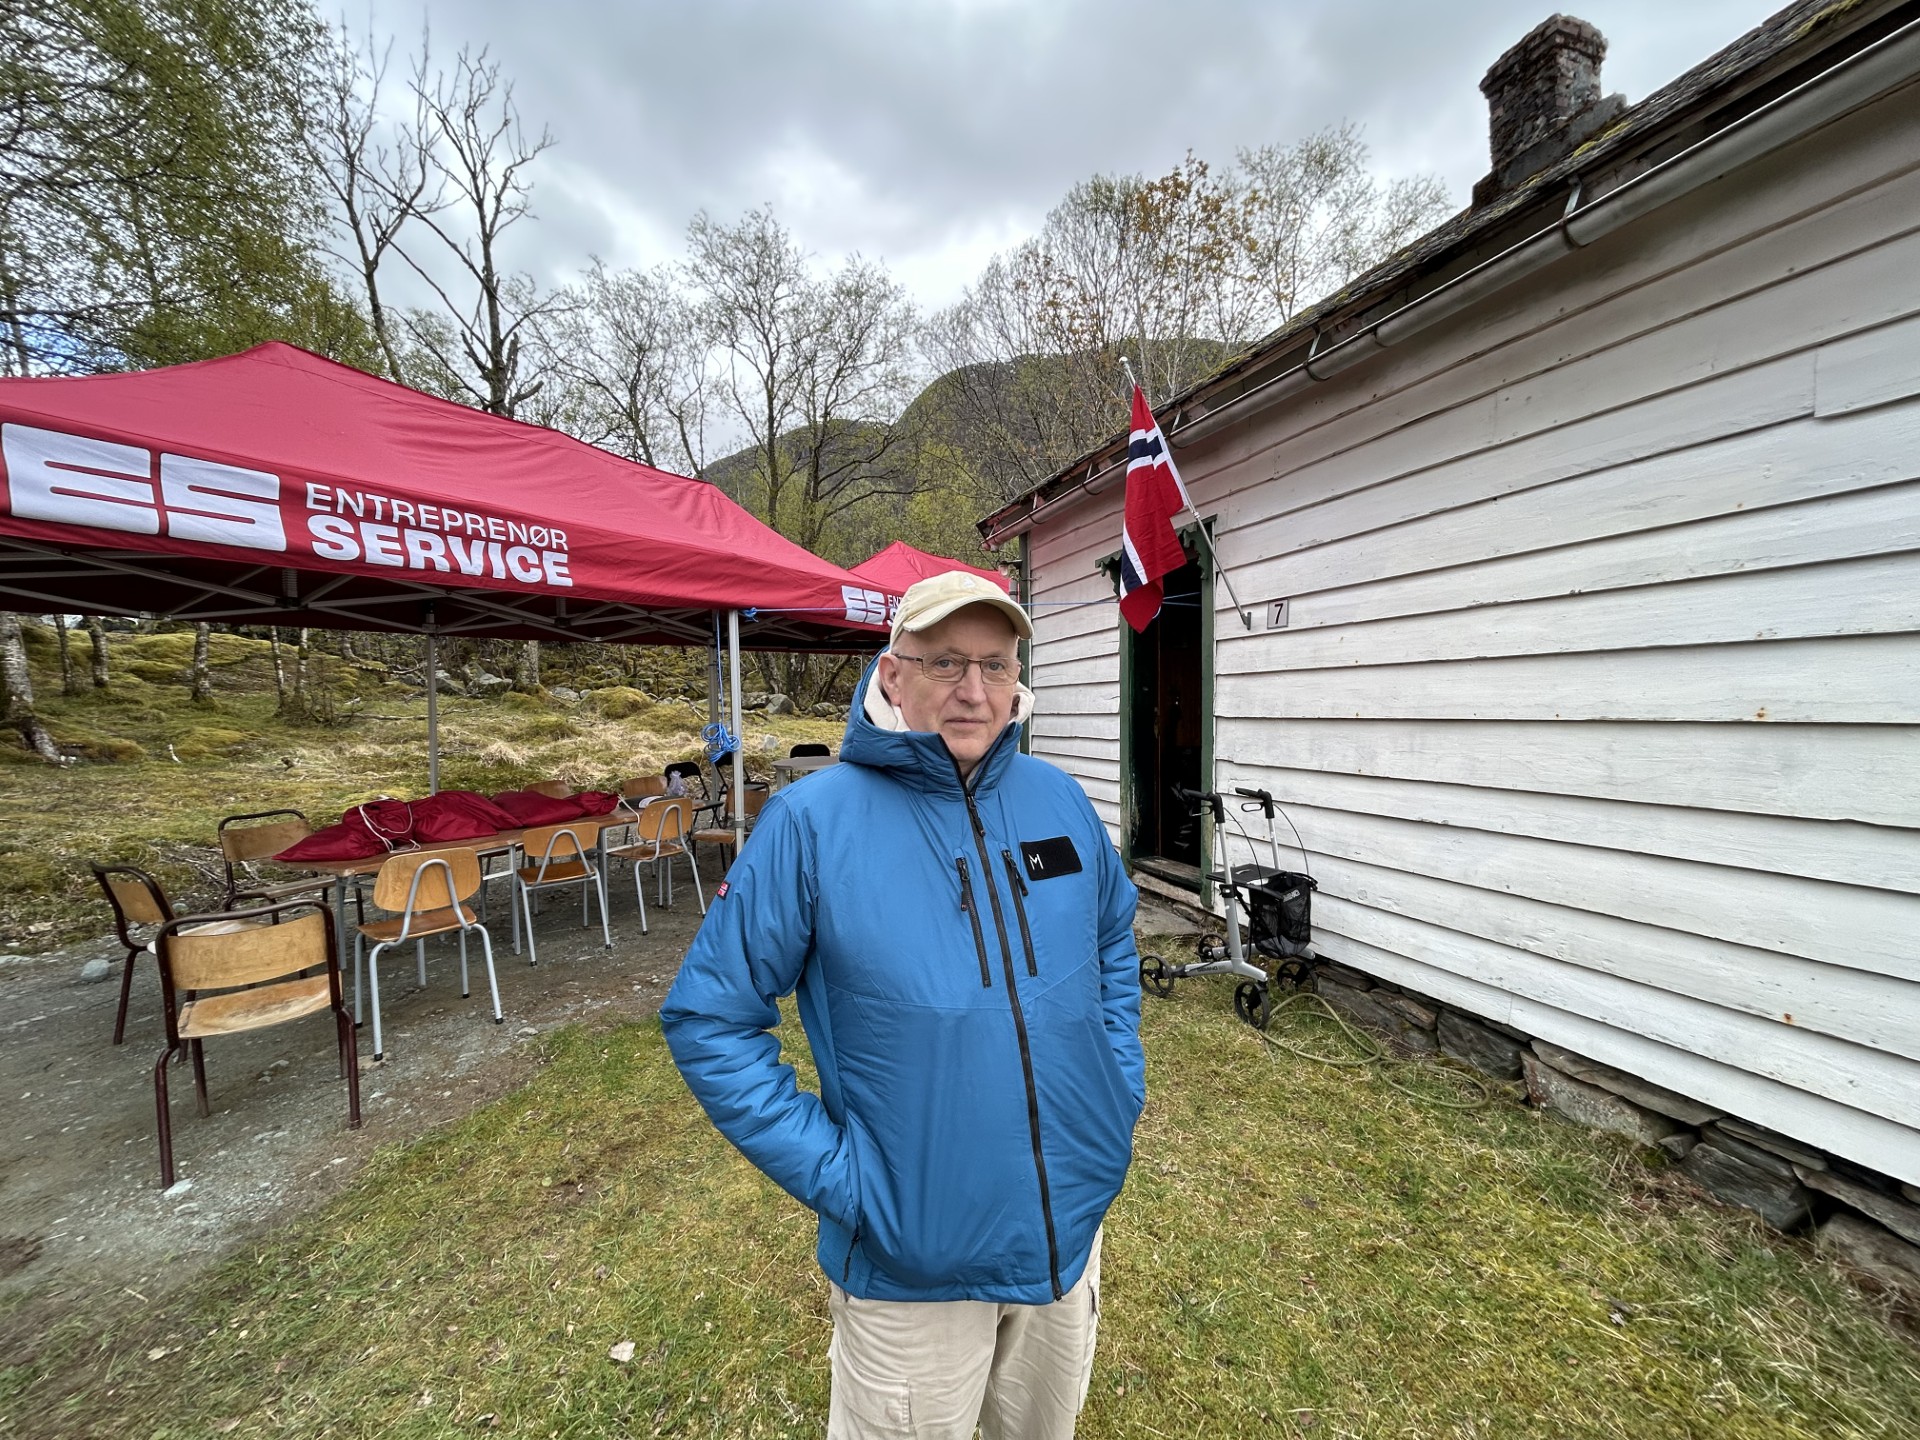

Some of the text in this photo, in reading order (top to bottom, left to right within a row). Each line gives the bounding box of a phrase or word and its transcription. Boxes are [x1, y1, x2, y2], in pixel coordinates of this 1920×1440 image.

[2, 422, 287, 552] ES
[305, 482, 568, 551] ENTREPRENØR
[307, 514, 573, 587] SERVICE
[841, 585, 886, 626] ES
[1274, 603, 1284, 625] 7
[1028, 853, 1044, 870] M
